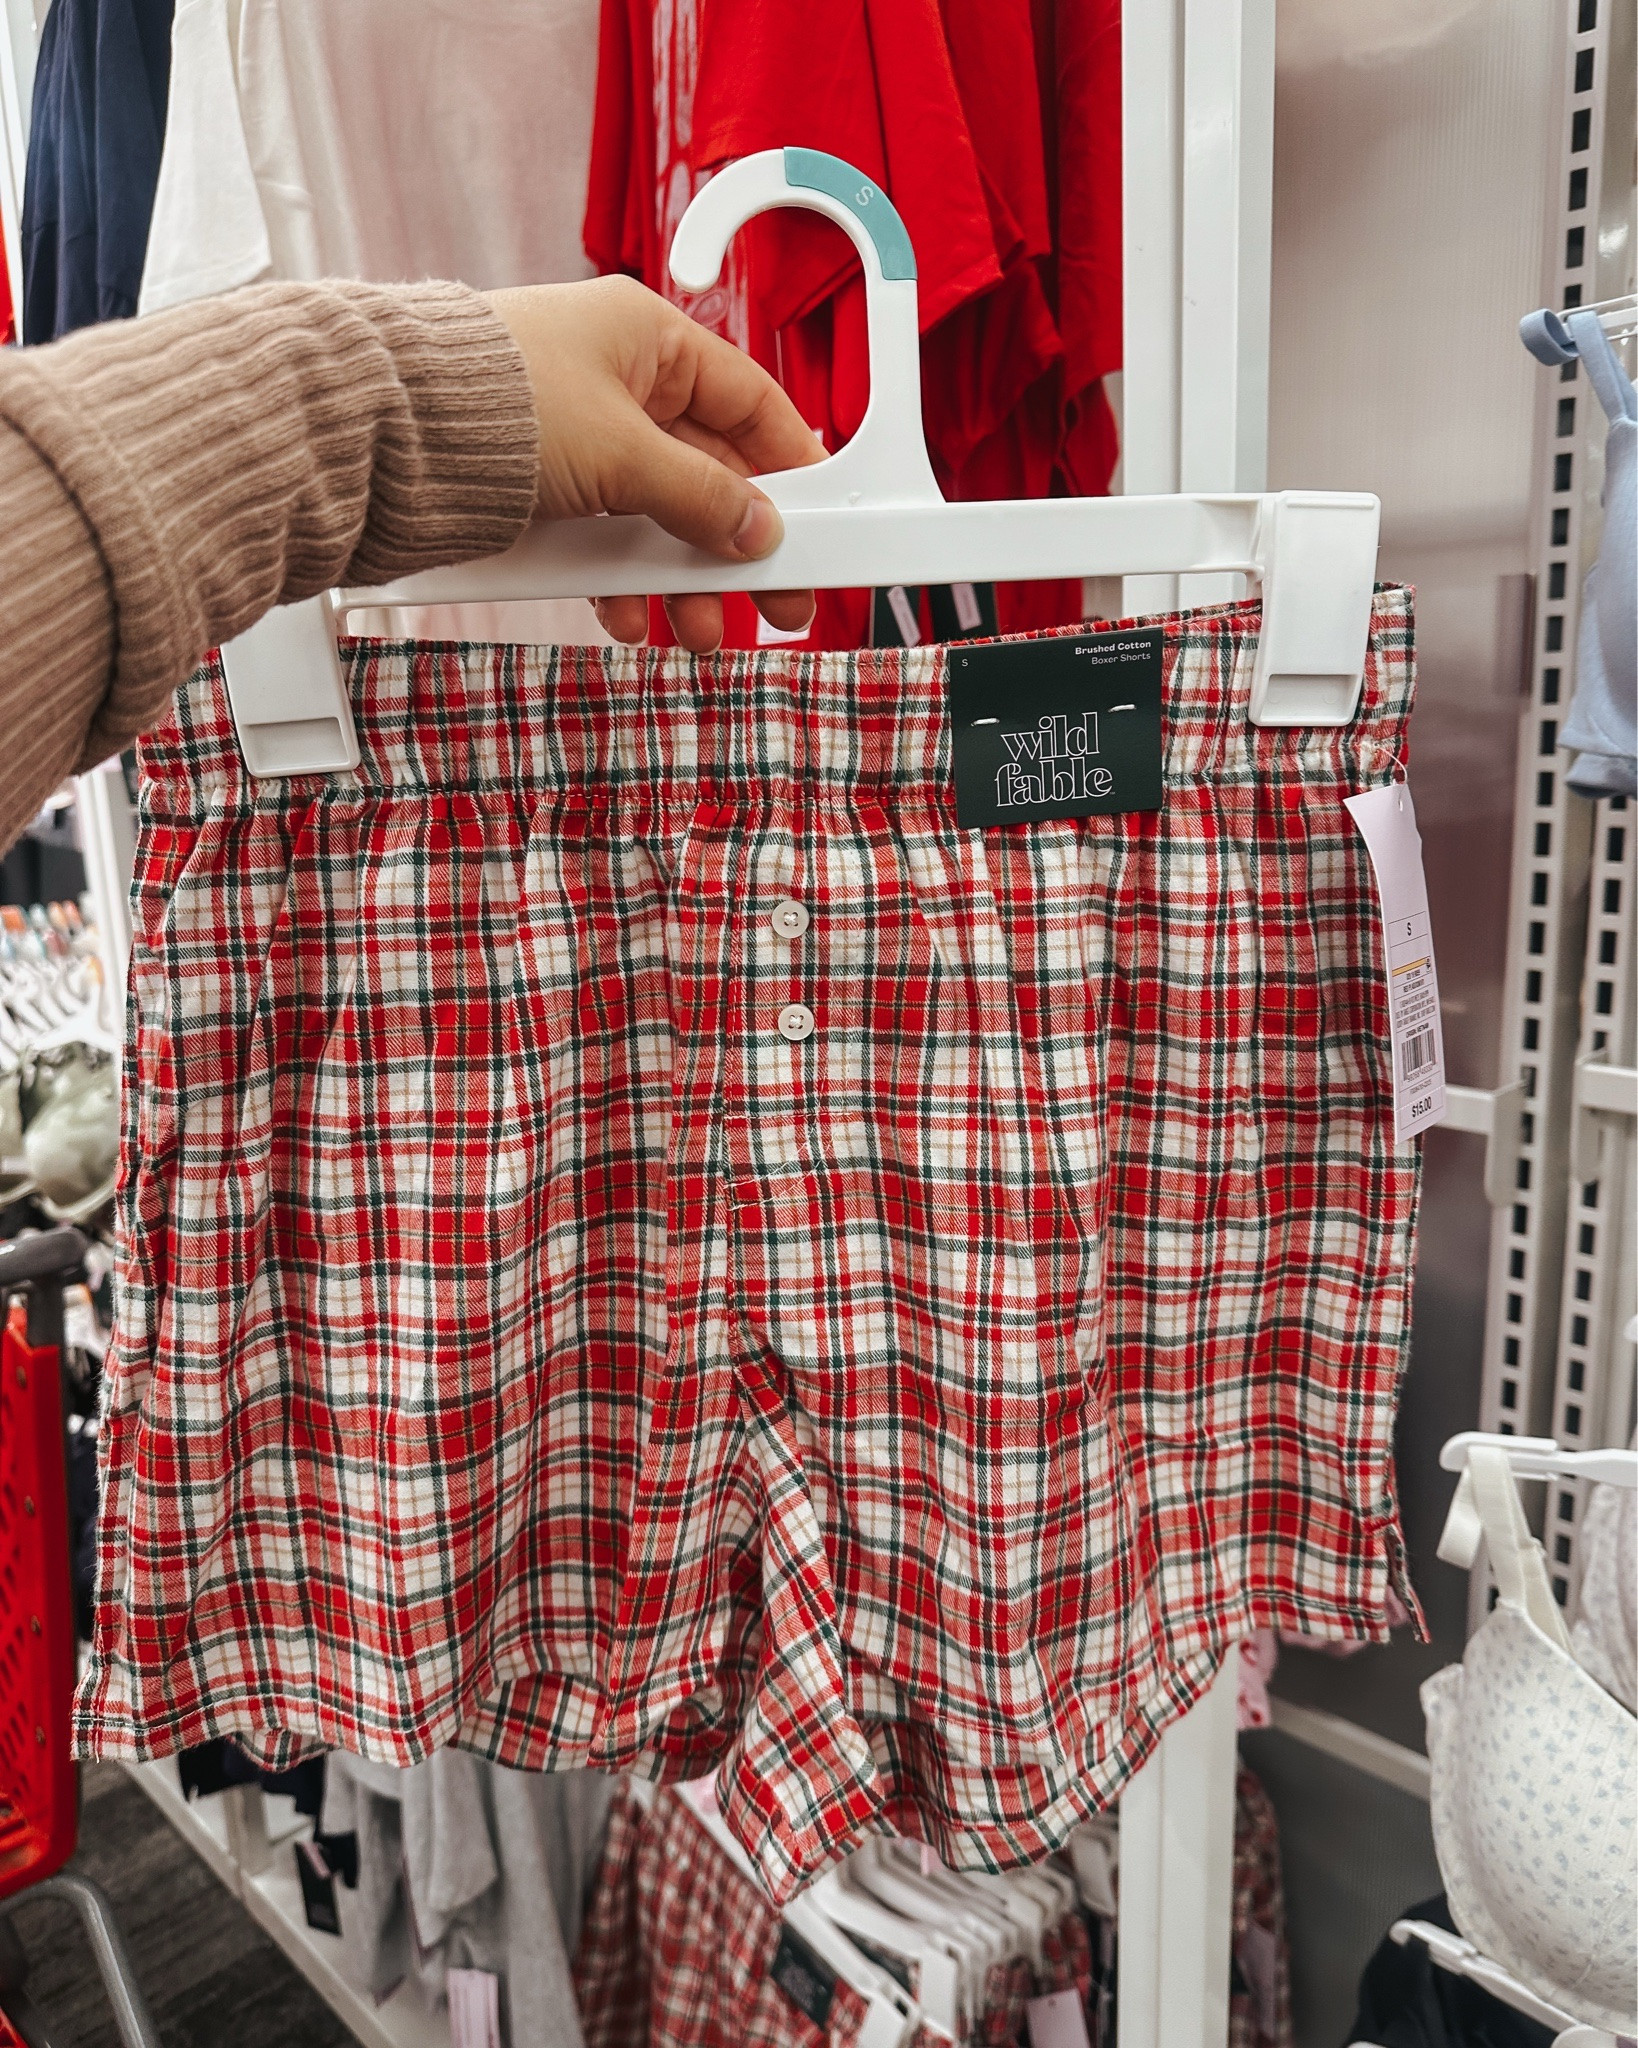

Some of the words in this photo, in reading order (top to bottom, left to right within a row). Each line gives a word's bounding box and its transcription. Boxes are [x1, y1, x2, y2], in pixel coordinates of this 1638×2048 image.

[855, 186, 874, 206] S
[1075, 643, 1115, 655] Brushed
[1117, 641, 1152, 651] Cotton
[961, 658, 969, 667] S
[1091, 656, 1118, 665] Boxer
[1120, 652, 1151, 662] Shorts
[1000, 711, 1100, 762] wild
[994, 756, 1113, 807] fable
[1406, 921, 1412, 936] S
[1411, 1096, 1432, 1118] $15.00
